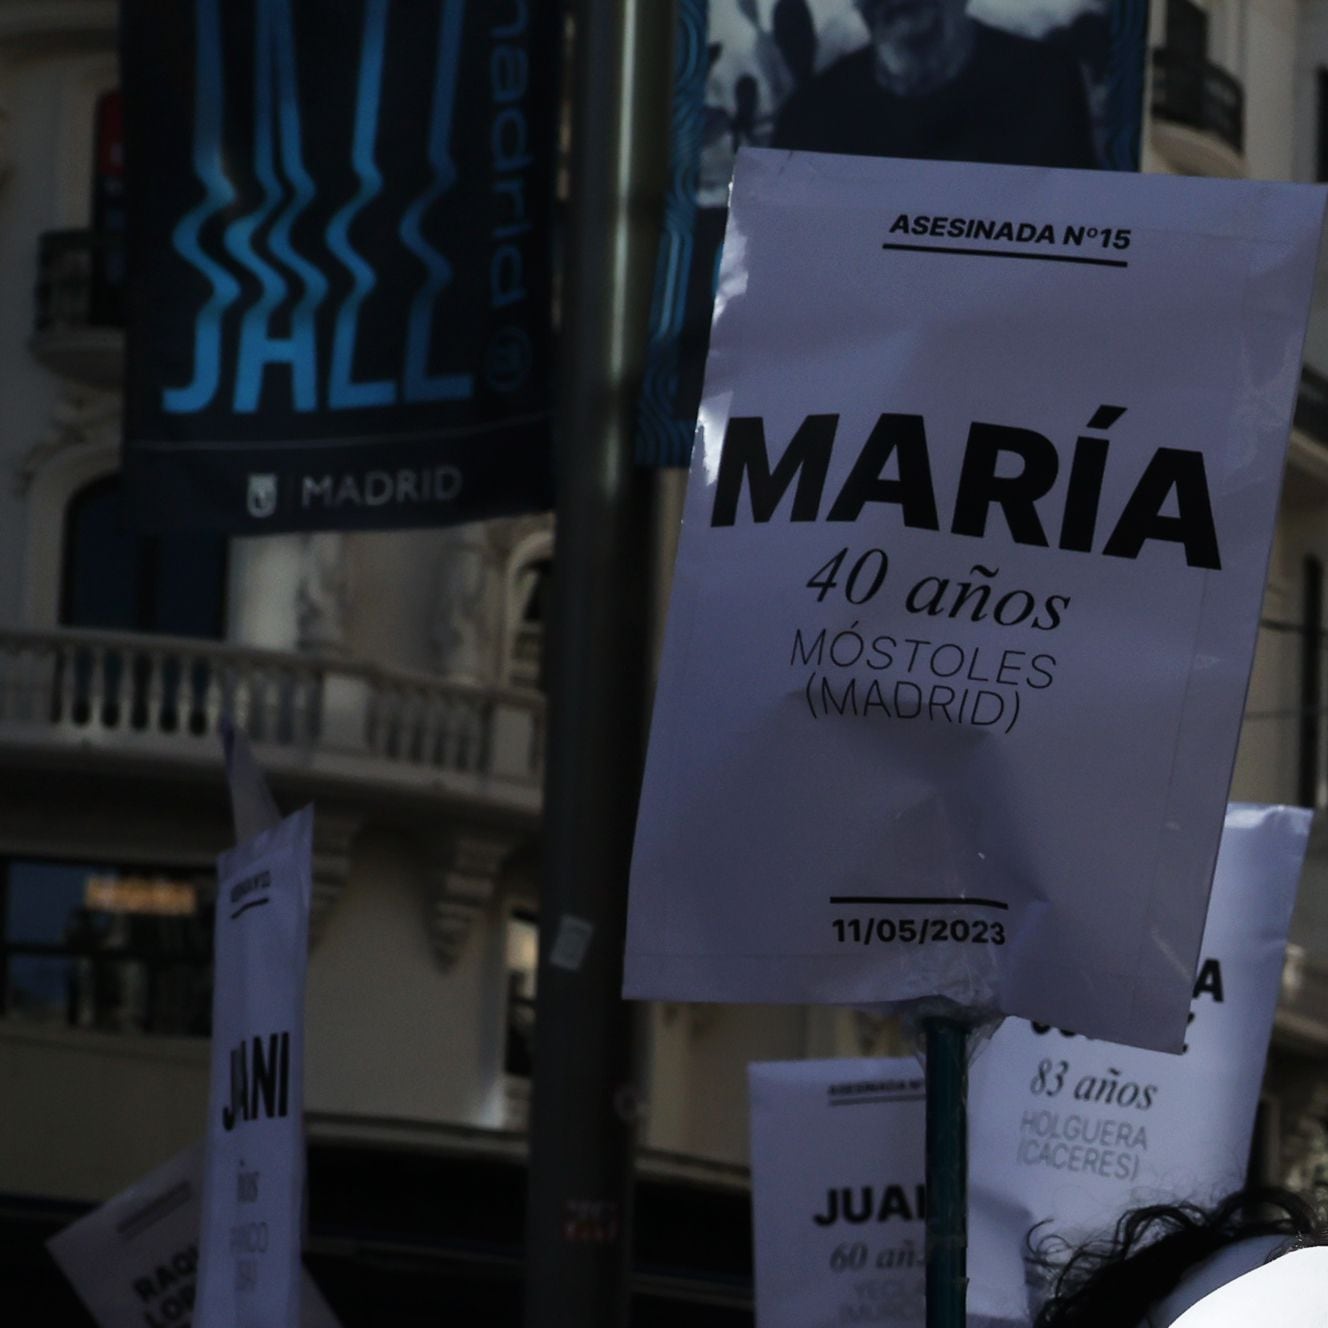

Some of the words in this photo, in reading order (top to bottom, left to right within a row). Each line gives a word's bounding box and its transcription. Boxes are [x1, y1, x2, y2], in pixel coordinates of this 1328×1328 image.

[889, 214, 1054, 246] ASESINADA
[1062, 225, 1131, 250] Nº15
[301, 466, 463, 510] MADRID
[710, 405, 1221, 570] MARÍA
[806, 547, 889, 605] 40
[905, 564, 1070, 631] años
[790, 622, 1056, 689] MÓSTOLES
[804, 672, 1021, 733] (MADRID)
[832, 919, 1005, 944] 11/05/2023
[1030, 1058, 1069, 1097] 83
[1074, 1068, 1158, 1111] años
[1020, 1110, 1147, 1150] HOLGUERA
[830, 1241, 868, 1273] 60
[876, 1240, 926, 1268] añ
